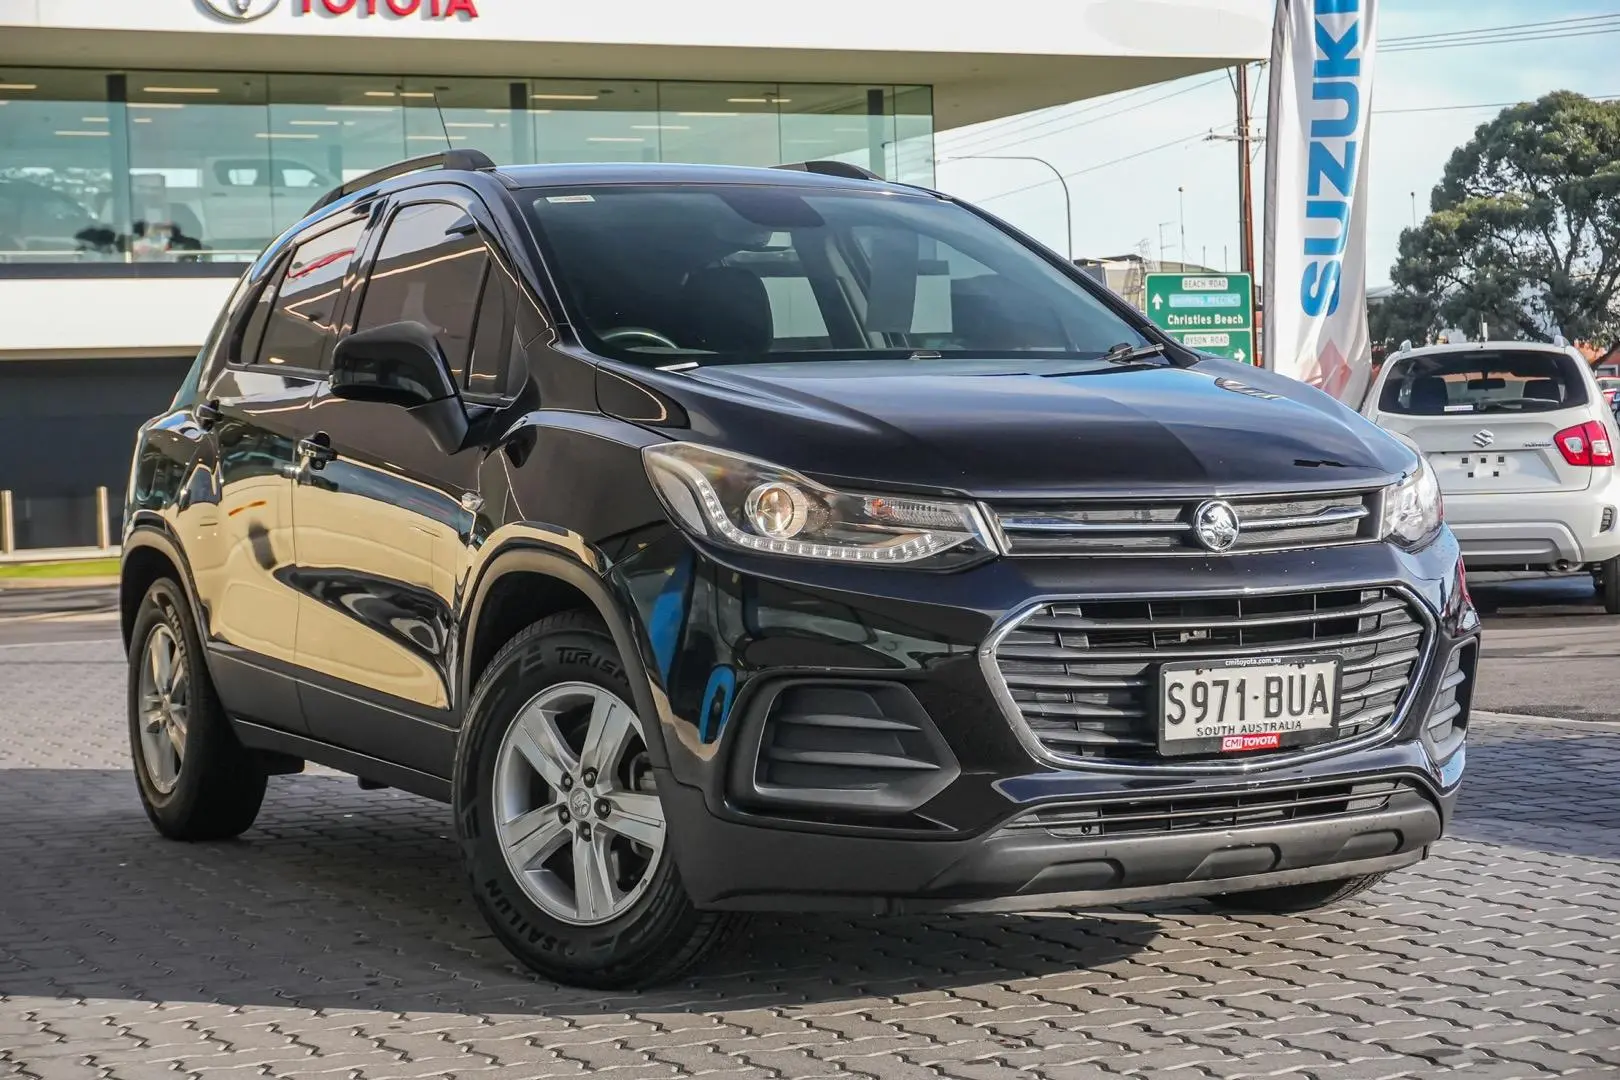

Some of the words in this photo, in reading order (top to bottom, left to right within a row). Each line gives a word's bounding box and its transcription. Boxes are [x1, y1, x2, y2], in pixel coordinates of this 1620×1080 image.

[1300, 0, 1361, 317] SUZUKI
[1184, 279, 1206, 289] BEACH
[1208, 279, 1227, 288] ROAD
[1167, 314, 1212, 325] Christies
[1214, 313, 1244, 324] Beach
[1210, 335, 1229, 344] ROAD
[1225, 657, 1282, 667] cmitoyota.com.au
[1196, 725, 1235, 737] SOUTH
[1240, 720, 1302, 733] AUSTRALIA
[1243, 735, 1278, 746] TOYOTA
